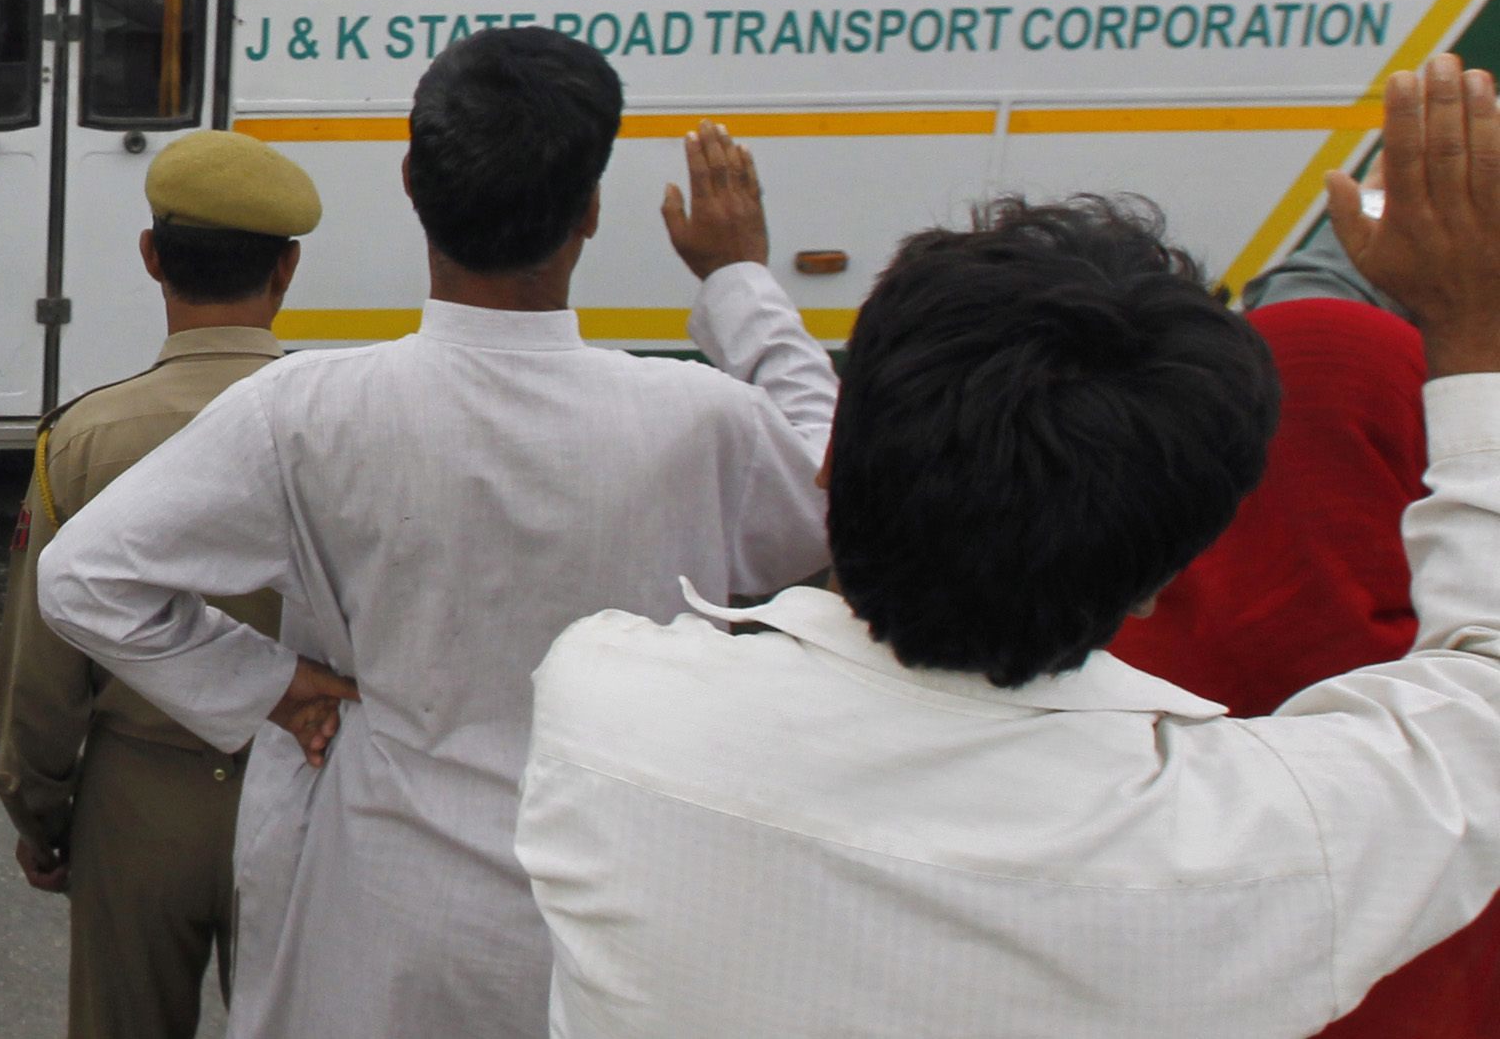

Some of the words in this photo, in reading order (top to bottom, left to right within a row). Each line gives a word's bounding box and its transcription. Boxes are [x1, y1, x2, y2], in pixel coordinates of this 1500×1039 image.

[245, 17, 271, 62] J
[288, 17, 320, 60] &
[338, 16, 370, 60] K
[707, 7, 1013, 54] TRANSPORT
[1023, 2, 1393, 51] CORPORATION
